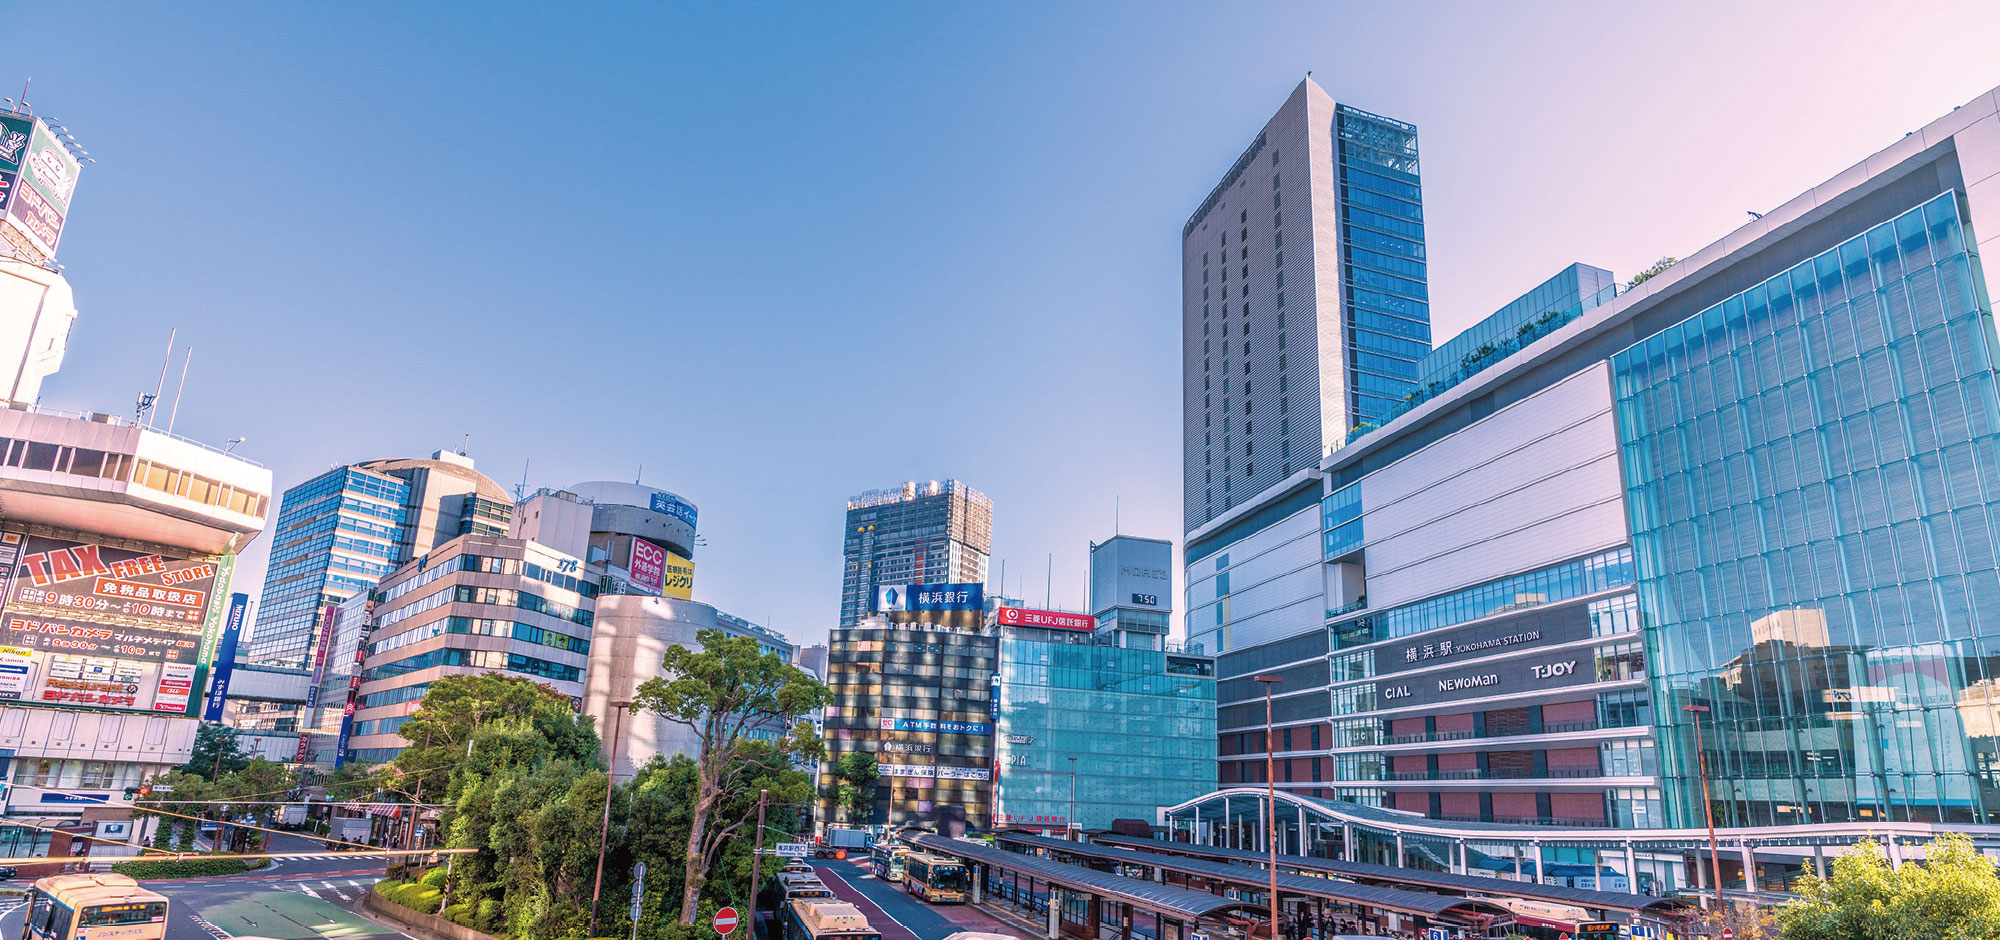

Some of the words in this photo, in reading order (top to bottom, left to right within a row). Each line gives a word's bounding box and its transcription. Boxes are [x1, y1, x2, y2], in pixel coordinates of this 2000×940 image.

[24, 210, 57, 246] カメラ
[635, 541, 662, 565] ECC
[22, 544, 111, 587] TAX
[110, 554, 167, 580] FREE
[161, 564, 214, 586] STORE
[557, 558, 578, 573] 178
[665, 574, 692, 589] レジクリ
[102, 582, 198, 605] 免税品取扱店
[918, 591, 968, 604] 横浜銀行
[231, 604, 244, 631] MIZUHO
[1025, 613, 1088, 628] 三菱UFJ信託銀行
[10, 618, 113, 640] ヨドバシカメラ
[1455, 640, 1501, 653] YOKOHAMA
[1503, 631, 1540, 645] STATION
[2, 648, 26, 656] Nikon
[1405, 641, 1453, 663] 横浜駅
[46, 678, 123, 693] Restaurant
[1385, 686, 1411, 700] CIAL
[43, 690, 136, 706] ヨドバシカメラ
[896, 743, 931, 752] 横浜銀行
[1011, 755, 1026, 766] PIA
[1433, 931, 1439, 940] 6
